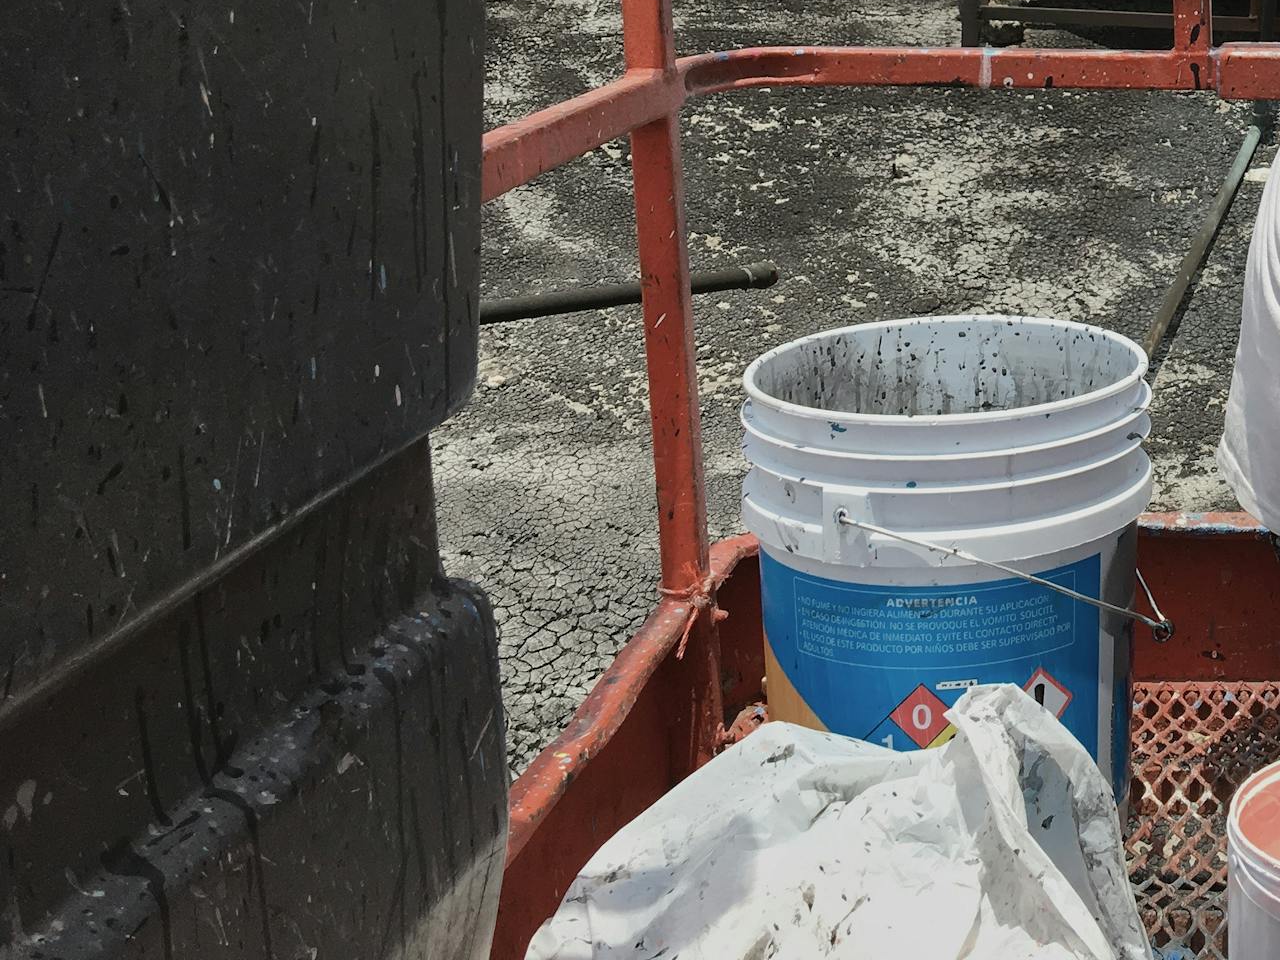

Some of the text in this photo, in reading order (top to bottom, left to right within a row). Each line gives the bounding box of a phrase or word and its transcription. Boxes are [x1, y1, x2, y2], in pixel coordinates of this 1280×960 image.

[851, 607, 885, 618] INGIERA
[940, 607, 983, 618] DURANTE
[986, 605, 998, 614] SU
[886, 596, 977, 608] ADVERTENCIA
[811, 610, 830, 622] CASO
[889, 622, 904, 631] NO
[905, 622, 915, 631] SE
[917, 620, 968, 631] PROVOQUE
[970, 618, 980, 628] EL
[811, 632, 825, 643] USO
[826, 637, 836, 647] DE
[837, 640, 855, 650] ESTE
[856, 641, 904, 654] PRODUCTO
[905, 645, 923, 654] POR
[925, 642, 954, 654] NIÑOS
[956, 642, 979, 653] DEBE
[981, 639, 998, 650] SER
[999, 626, 1056, 648] SUPERVISADO
[1056, 622, 1071, 633] POR
[869, 631, 880, 641] DE
[882, 633, 933, 642] INMEDIATO
[936, 631, 962, 641] EVITE
[963, 631, 974, 640] EL
[975, 623, 1023, 638] CONTACTO
[912, 704, 932, 730] 0
